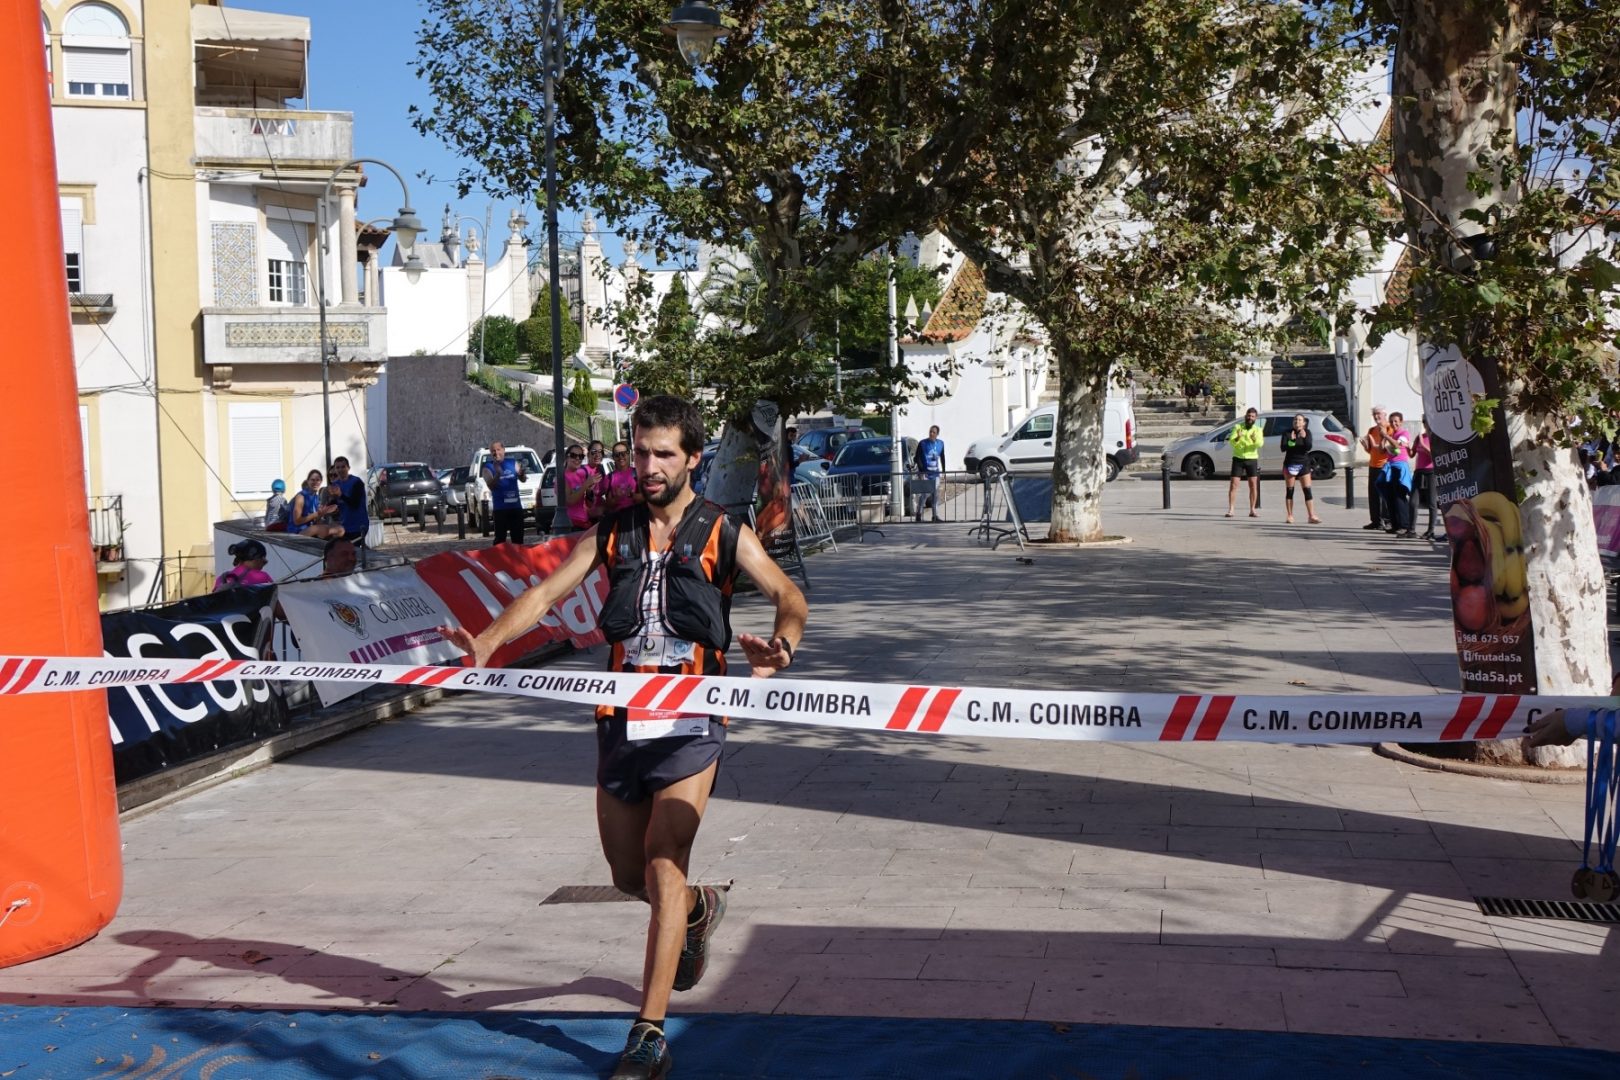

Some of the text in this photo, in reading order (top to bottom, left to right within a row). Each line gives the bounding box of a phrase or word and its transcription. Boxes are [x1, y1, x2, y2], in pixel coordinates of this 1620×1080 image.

[1434, 448, 1468, 468] equipa
[1436, 481, 1479, 505] saudável
[368, 596, 436, 624] COIMBRA
[1462, 633, 1520, 644] 968 675 057
[44, 669, 171, 687] C.M. COIMBRA
[240, 665, 383, 680] C.M. COIMBRA
[462, 672, 617, 694] C.M. COIMBRA
[706, 686, 872, 716] C.M. COIMBRA
[967, 700, 1142, 728] C.M. COIMBRA
[1243, 708, 1423, 731] C.M. COIMBRA
